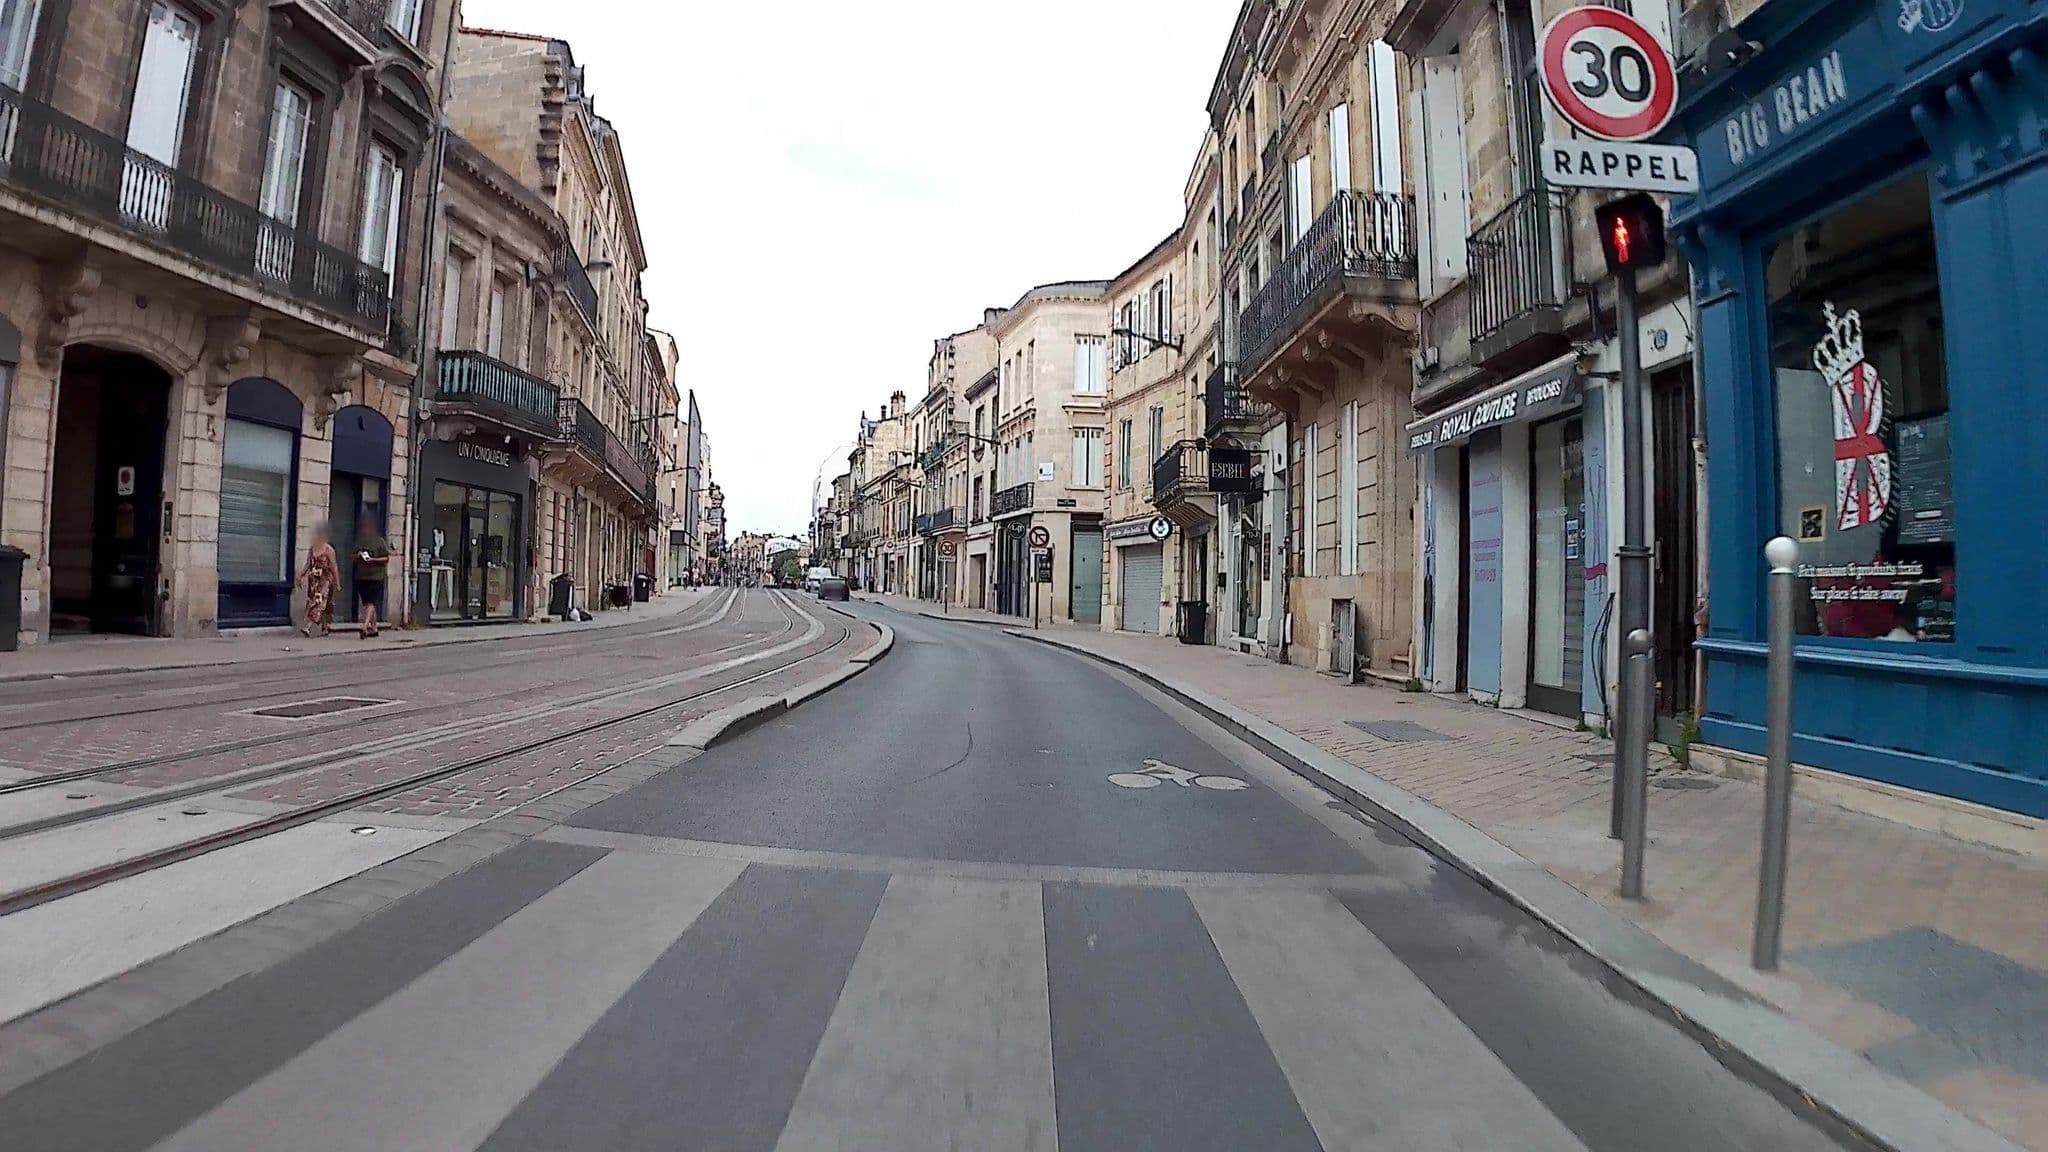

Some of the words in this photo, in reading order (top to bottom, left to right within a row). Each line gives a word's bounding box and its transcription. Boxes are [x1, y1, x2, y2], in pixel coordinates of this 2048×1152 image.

[1570, 40, 1652, 103] 30
[1726, 102, 1769, 167] BIG
[1775, 50, 1847, 134] BEAN
[1554, 149, 1689, 182] RAPPEL
[1440, 410, 1472, 442] ROYAL
[1472, 391, 1518, 428] COUTURE
[1810, 586, 1826, 599] Sur
[1825, 585, 1849, 603] place
